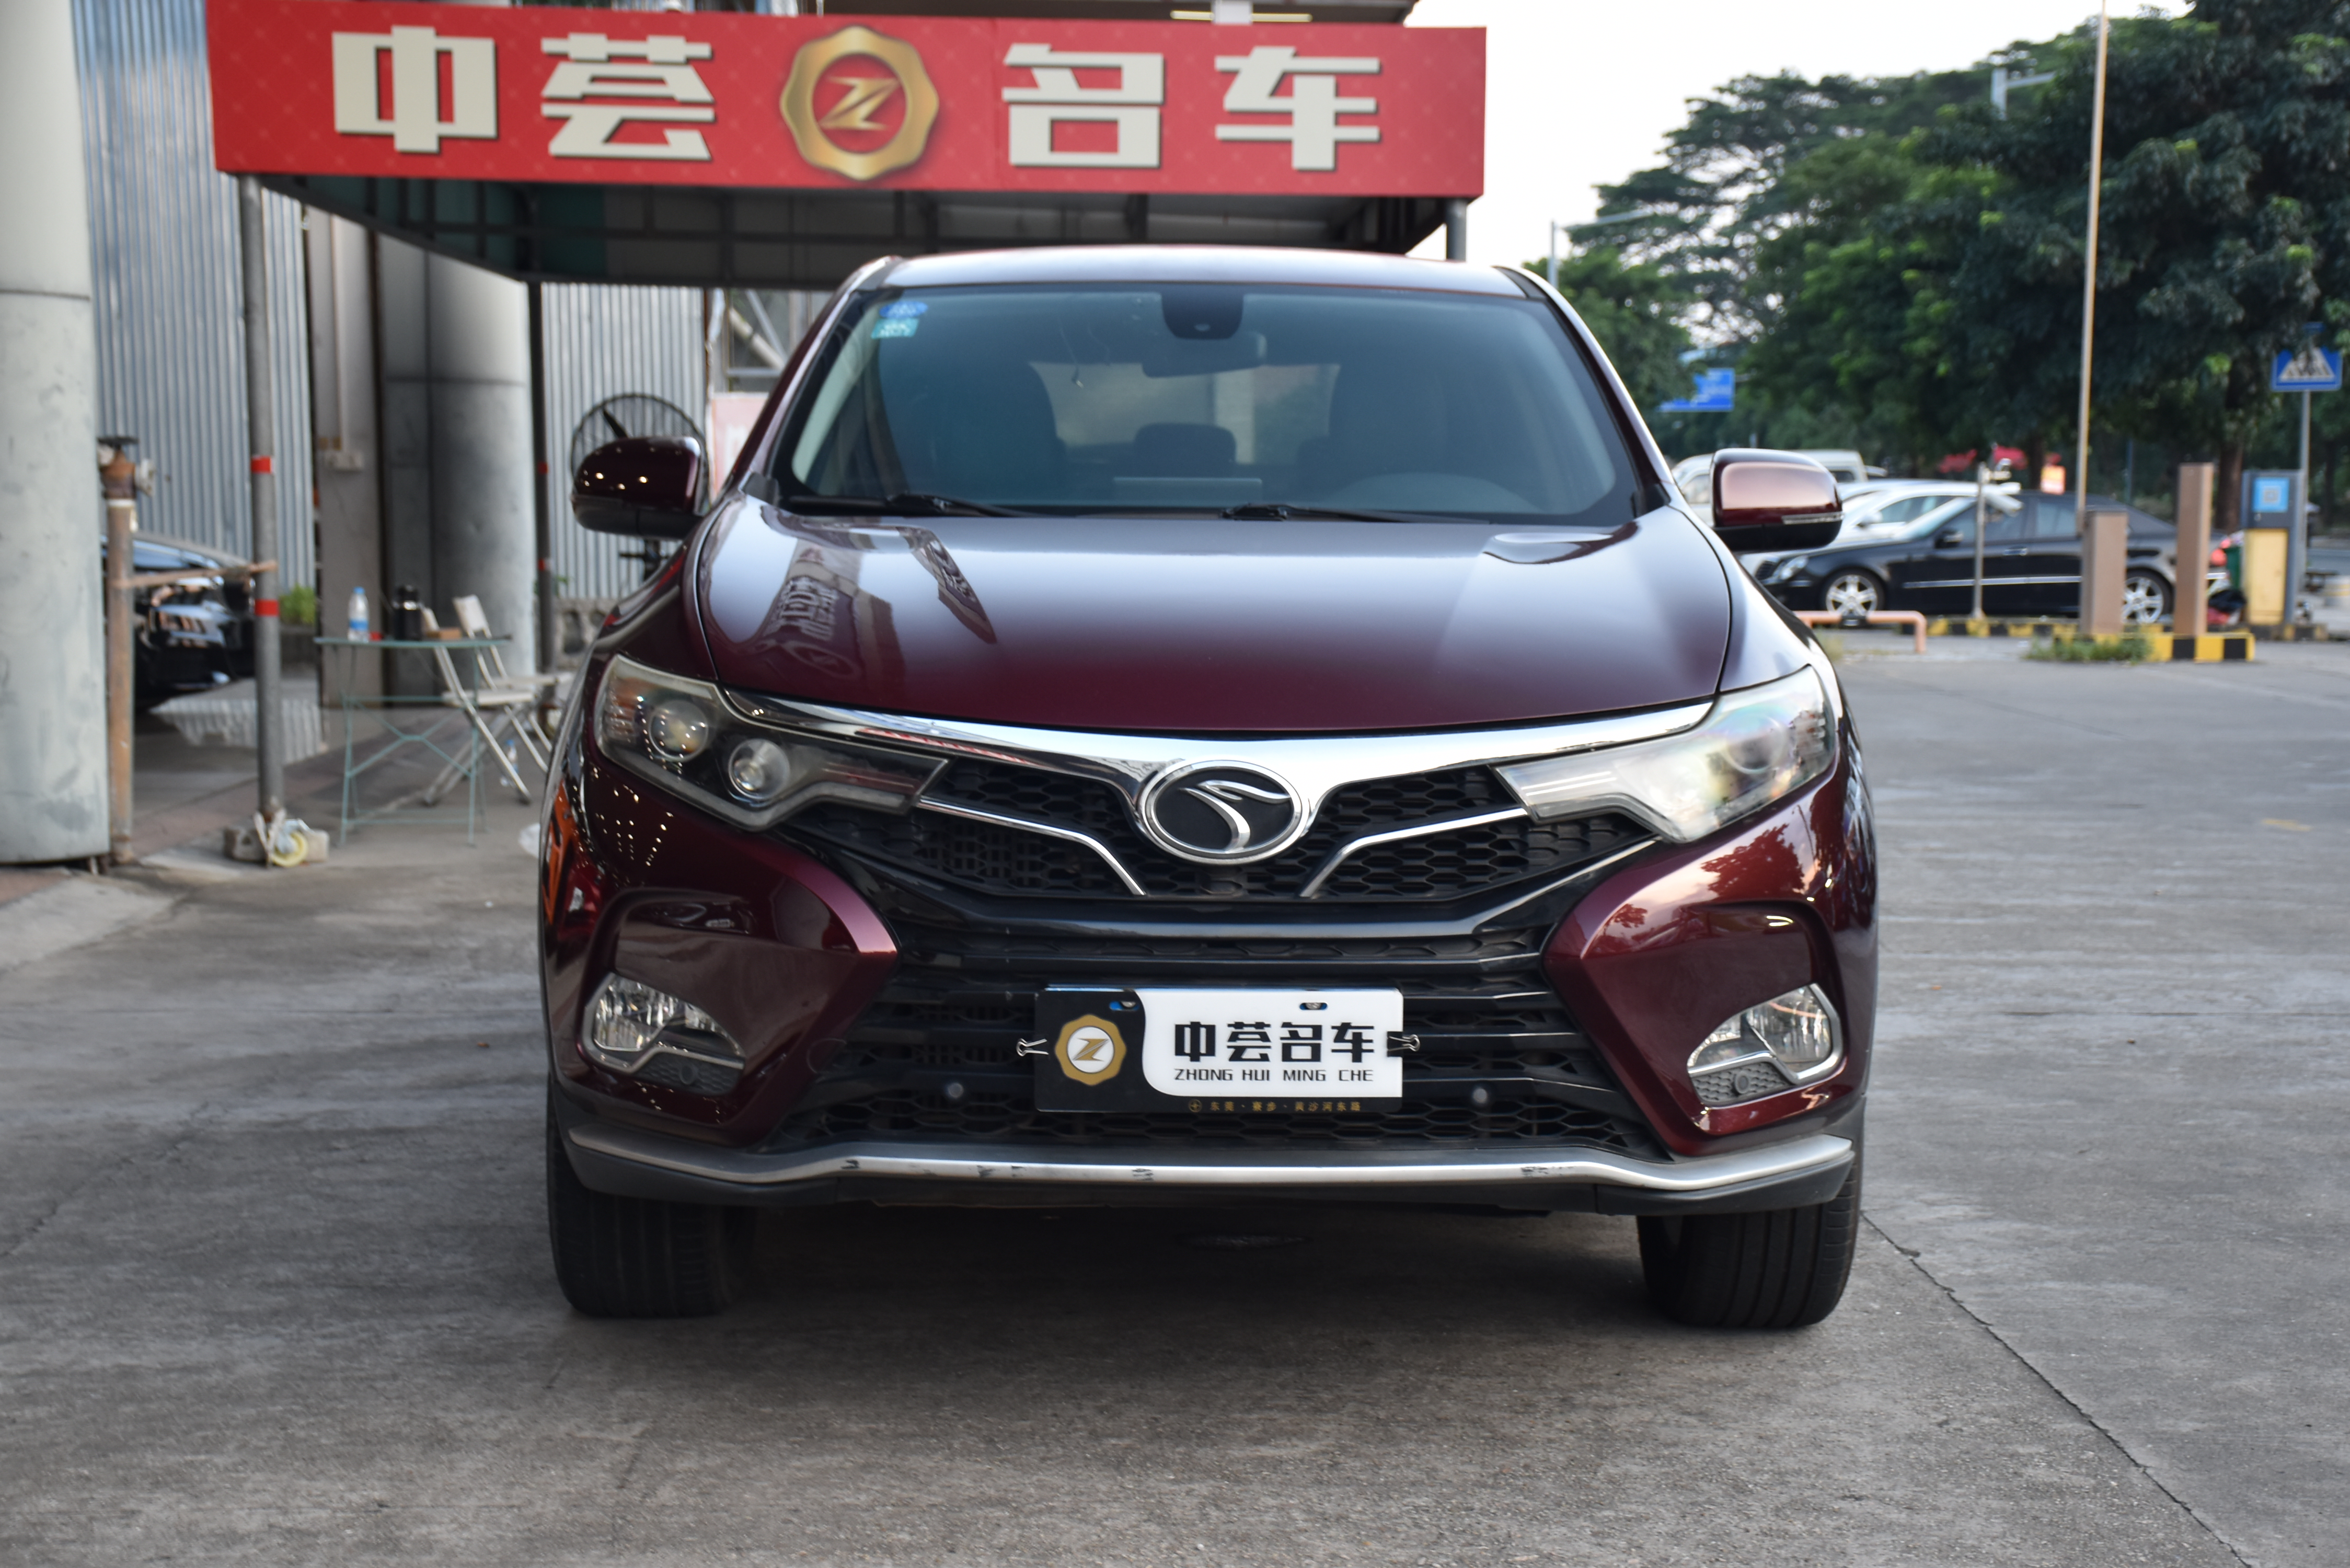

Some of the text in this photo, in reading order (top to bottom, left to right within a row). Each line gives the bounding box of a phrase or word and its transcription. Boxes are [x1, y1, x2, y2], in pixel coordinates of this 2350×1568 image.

[1174, 1021, 1375, 1063] 中荟名车
[1174, 1068, 1374, 1082] ZHONG HUI MING CHE
